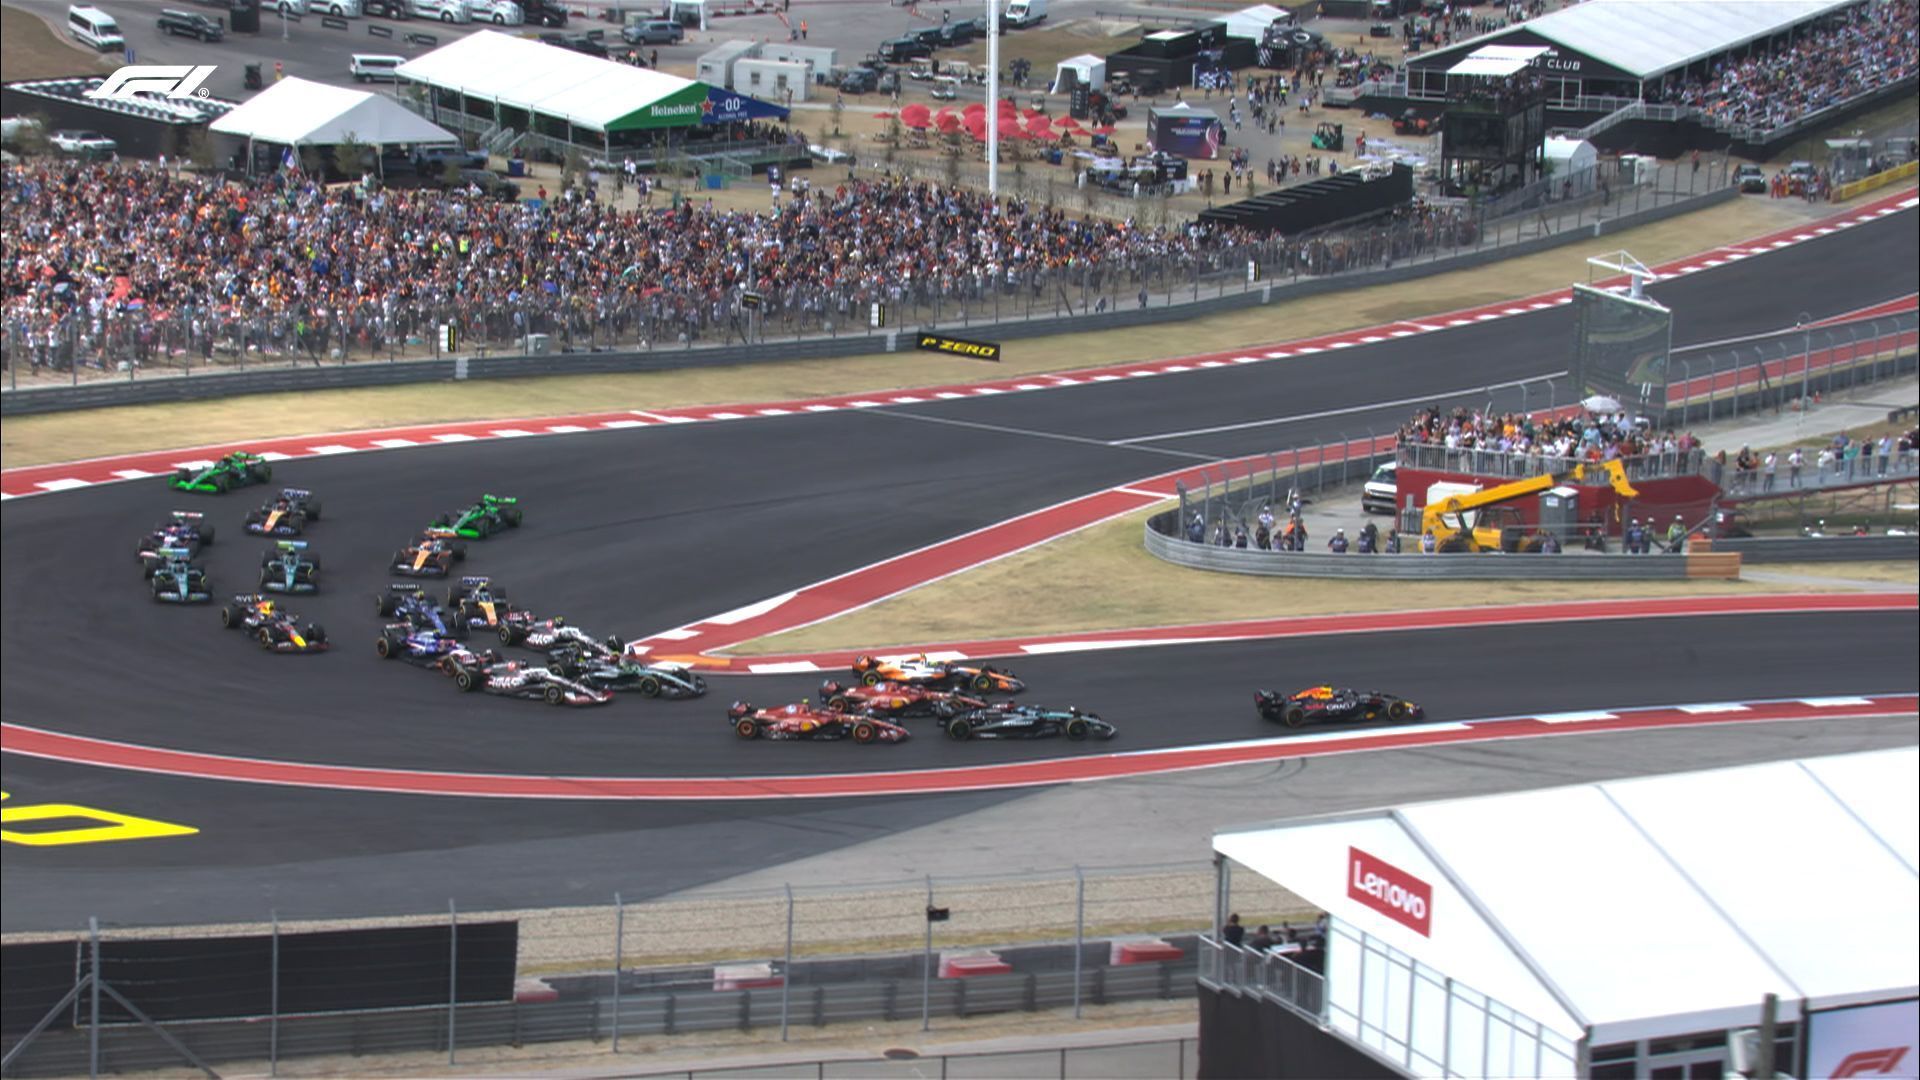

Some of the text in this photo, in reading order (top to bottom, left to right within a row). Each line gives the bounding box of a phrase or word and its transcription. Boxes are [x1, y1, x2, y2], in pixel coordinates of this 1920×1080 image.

[1547, 59, 1581, 71] CLUB
[651, 102, 697, 117] Heineken
[921, 337, 996, 357] P ZERO
[1354, 860, 1426, 919] Lenovo
